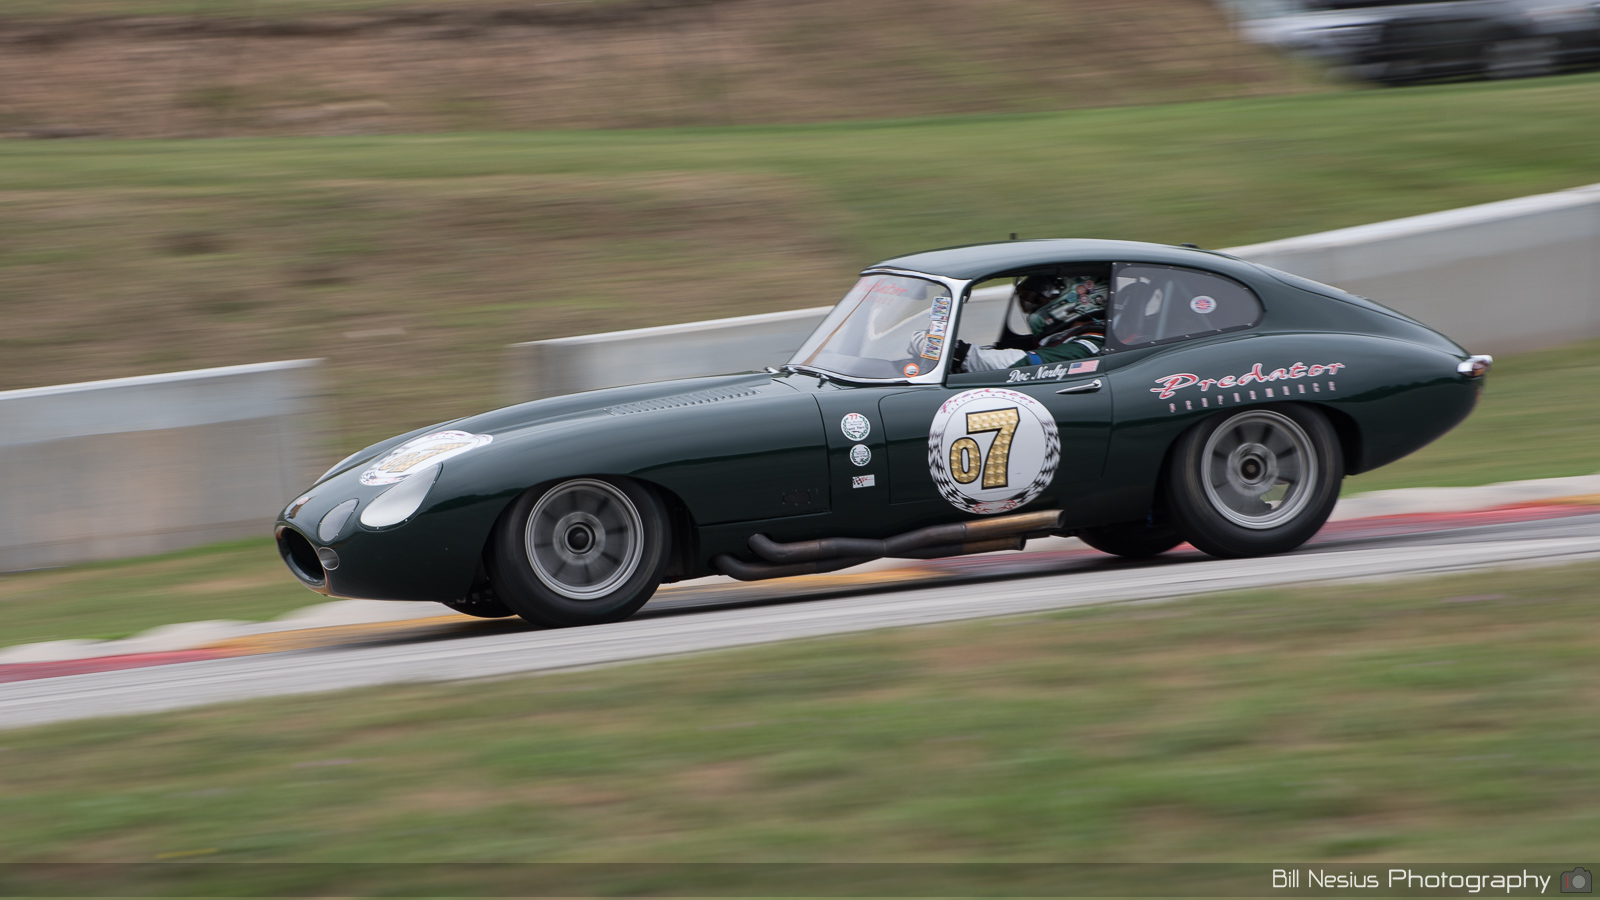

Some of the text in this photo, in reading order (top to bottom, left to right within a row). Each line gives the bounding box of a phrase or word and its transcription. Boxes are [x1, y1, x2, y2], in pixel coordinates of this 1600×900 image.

[1006, 363, 1068, 383] Doc Norby
[1150, 362, 1346, 399] Predator
[949, 407, 1020, 490] 07
